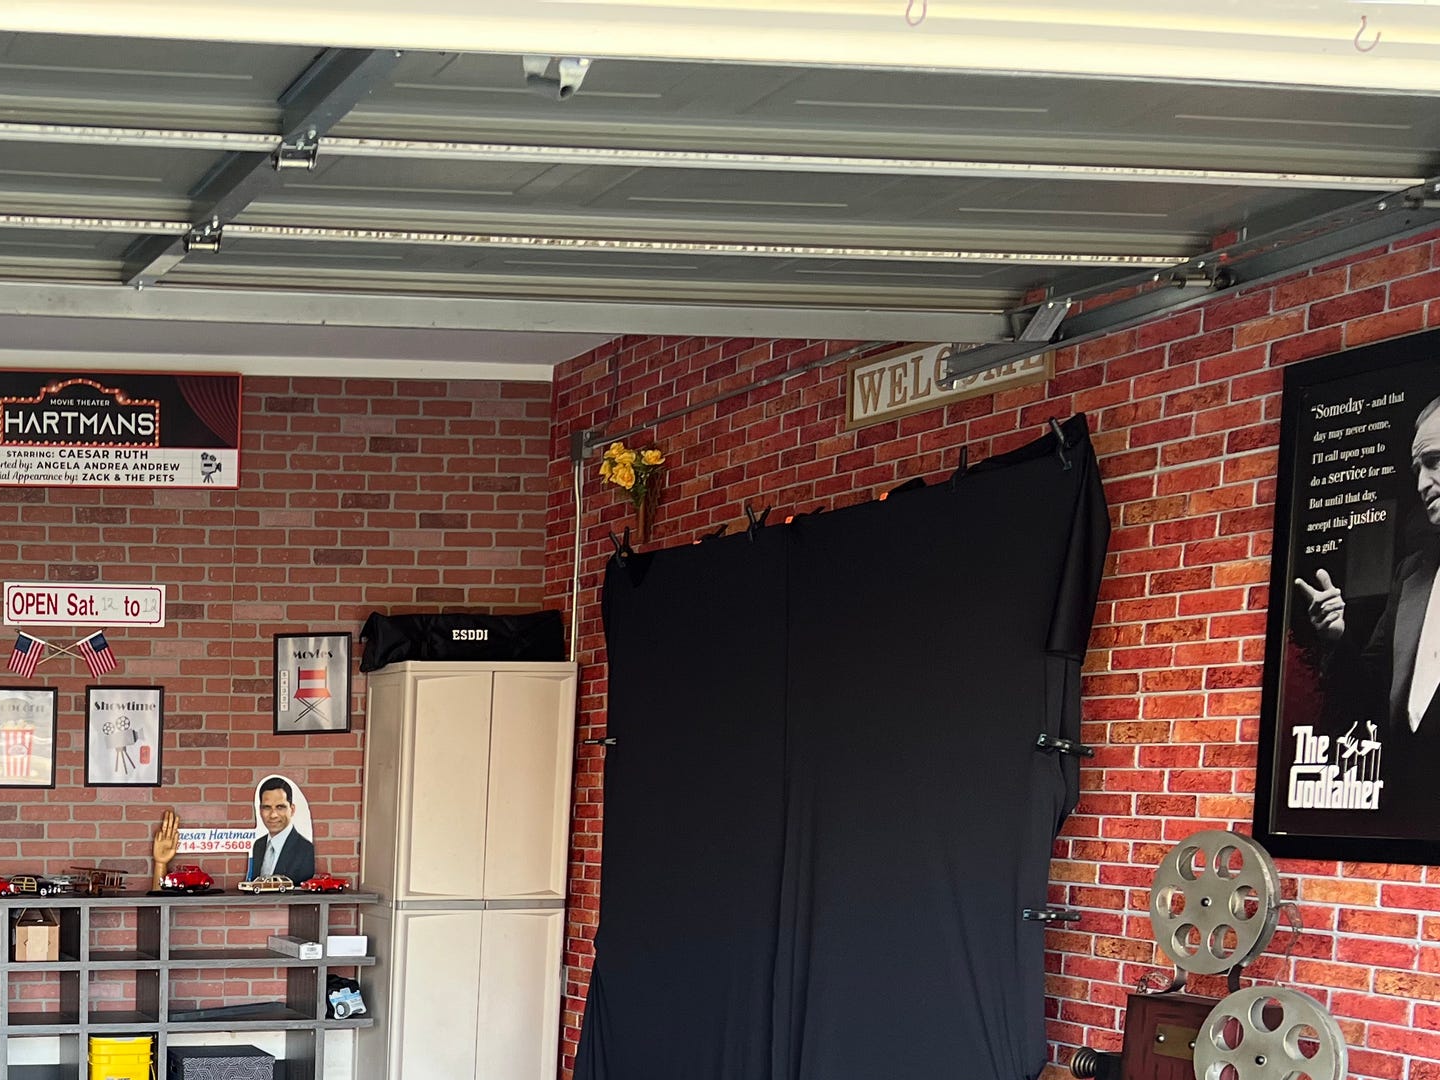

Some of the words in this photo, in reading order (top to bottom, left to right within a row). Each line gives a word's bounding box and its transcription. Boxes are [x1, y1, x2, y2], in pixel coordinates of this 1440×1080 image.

[50, 398, 74, 406] MOVIE
[1371, 394, 1387, 408] and
[1388, 391, 1405, 405] that
[5, 410, 155, 436] HARTMANS
[1313, 431, 1327, 443] day
[1328, 428, 1344, 440] may
[1345, 424, 1367, 436] never
[1368, 420, 1391, 431] come,
[6, 450, 55, 459] STARRING:
[59, 449, 110, 459] CAESAR
[115, 450, 148, 460] RUTH
[1324, 449, 1339, 462] call
[1340, 448, 1360, 462] upon
[1360, 445, 1375, 458] you
[1377, 442, 1386, 453] to
[18, 460, 33, 472] by:
[36, 461, 80, 470] ANGELA
[84, 462, 129, 471] ANDREA
[132, 463, 180, 471] ANDREW
[11, 472, 63, 484] Appearance
[64, 472, 78, 484] by:
[82, 473, 110, 481] ZACK
[114, 474, 121, 482] &
[125, 474, 145, 482] THE
[1310, 476, 1320, 487] do
[1321, 477, 1327, 485] a
[1328, 465, 1367, 484] service
[1368, 466, 1380, 477] for
[1309, 498, 1323, 510] But
[1324, 493, 1344, 507] until
[1345, 491, 1360, 504] that
[1361, 489, 1377, 503] day,
[1307, 519, 1331, 533] accept
[1333, 516, 1348, 528] this
[1347, 508, 1387, 530] justice
[1305, 544, 1315, 554] as
[1315, 544, 1321, 552] a
[12, 591, 58, 615] OPEN
[67, 592, 99, 616] Sat.
[124, 595, 141, 616] to
[452, 628, 489, 641] ESDDI
[93, 700, 157, 712] Showtime
[1292, 725, 1330, 764] The
[1287, 764, 1384, 810] Godfather
[178, 831, 206, 840] aesar
[208, 829, 257, 840] Hartman
